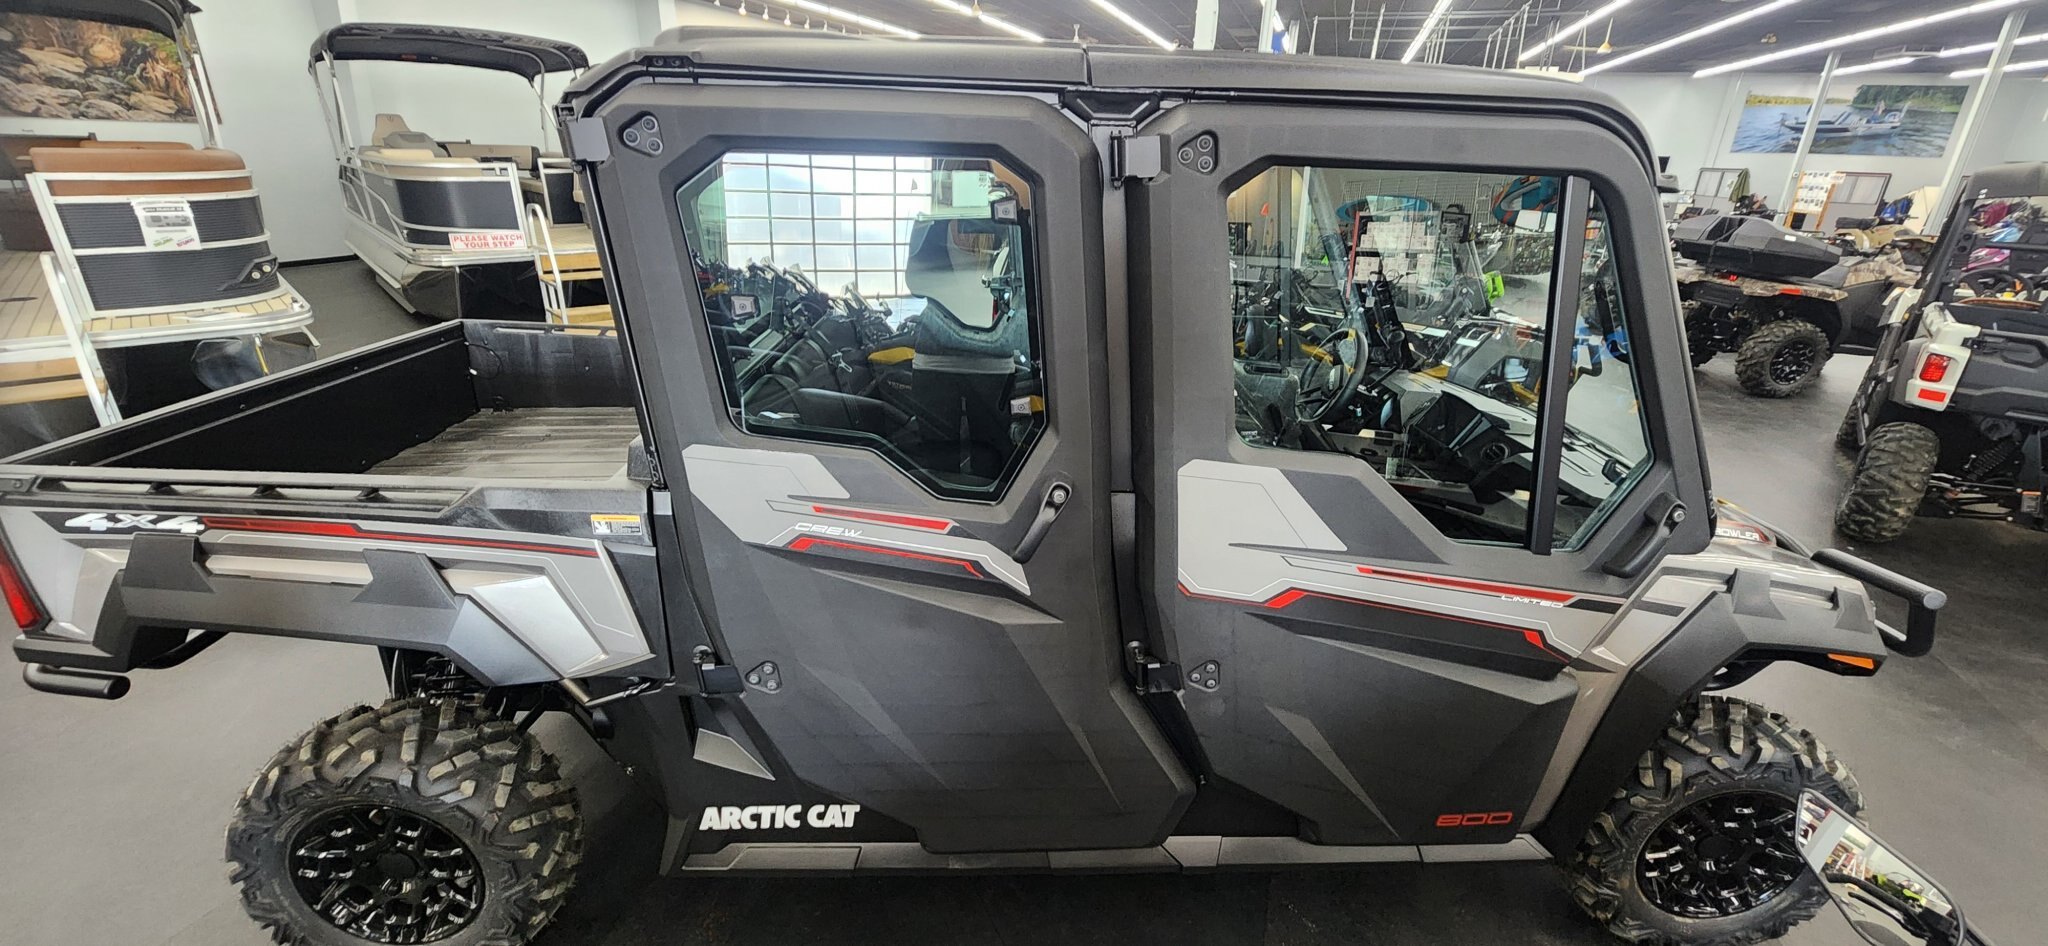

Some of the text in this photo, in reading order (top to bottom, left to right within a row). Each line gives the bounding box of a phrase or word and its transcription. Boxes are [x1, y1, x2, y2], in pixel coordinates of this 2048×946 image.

[464, 241, 490, 249] YOUR
[794, 522, 862, 537] CREW
[1501, 595, 1564, 609] LIMITED
[699, 804, 861, 830] ARCTIC CAT
